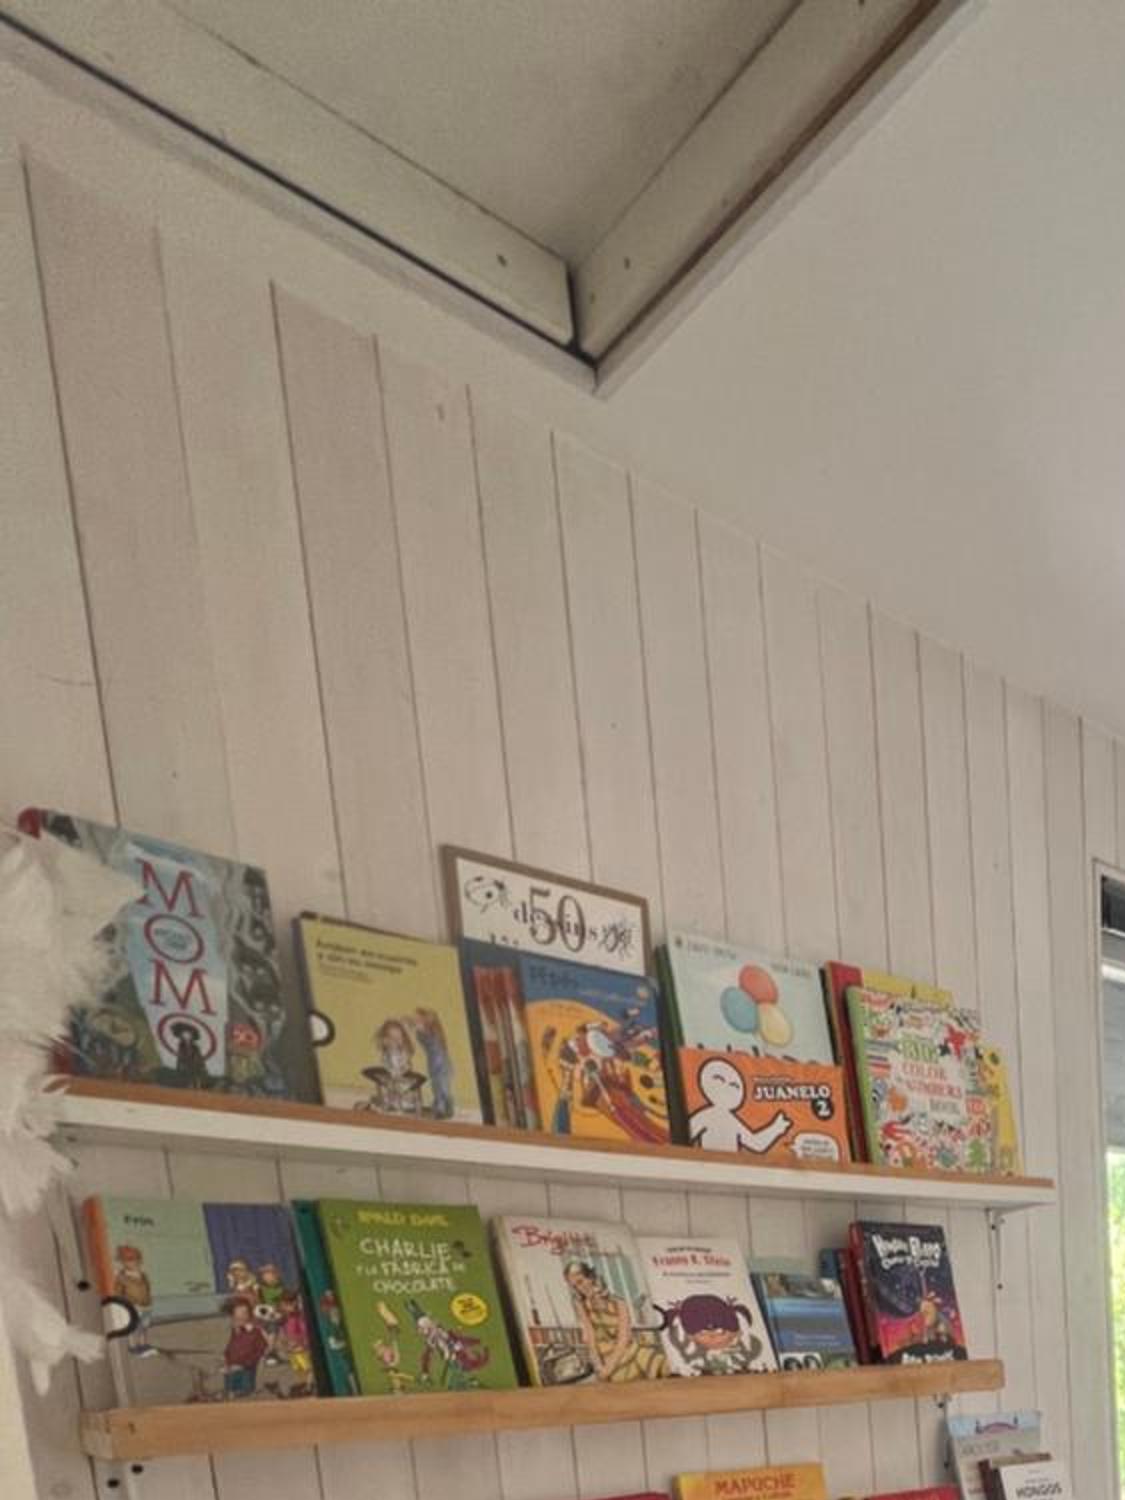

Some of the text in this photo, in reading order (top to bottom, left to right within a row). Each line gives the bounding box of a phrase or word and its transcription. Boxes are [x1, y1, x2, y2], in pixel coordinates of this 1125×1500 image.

[530, 886, 587, 953] 50
[753, 1085, 831, 1100] JUANELO
[816, 1099, 831, 1117] 2
[359, 1237, 452, 1261] CHARLIE
